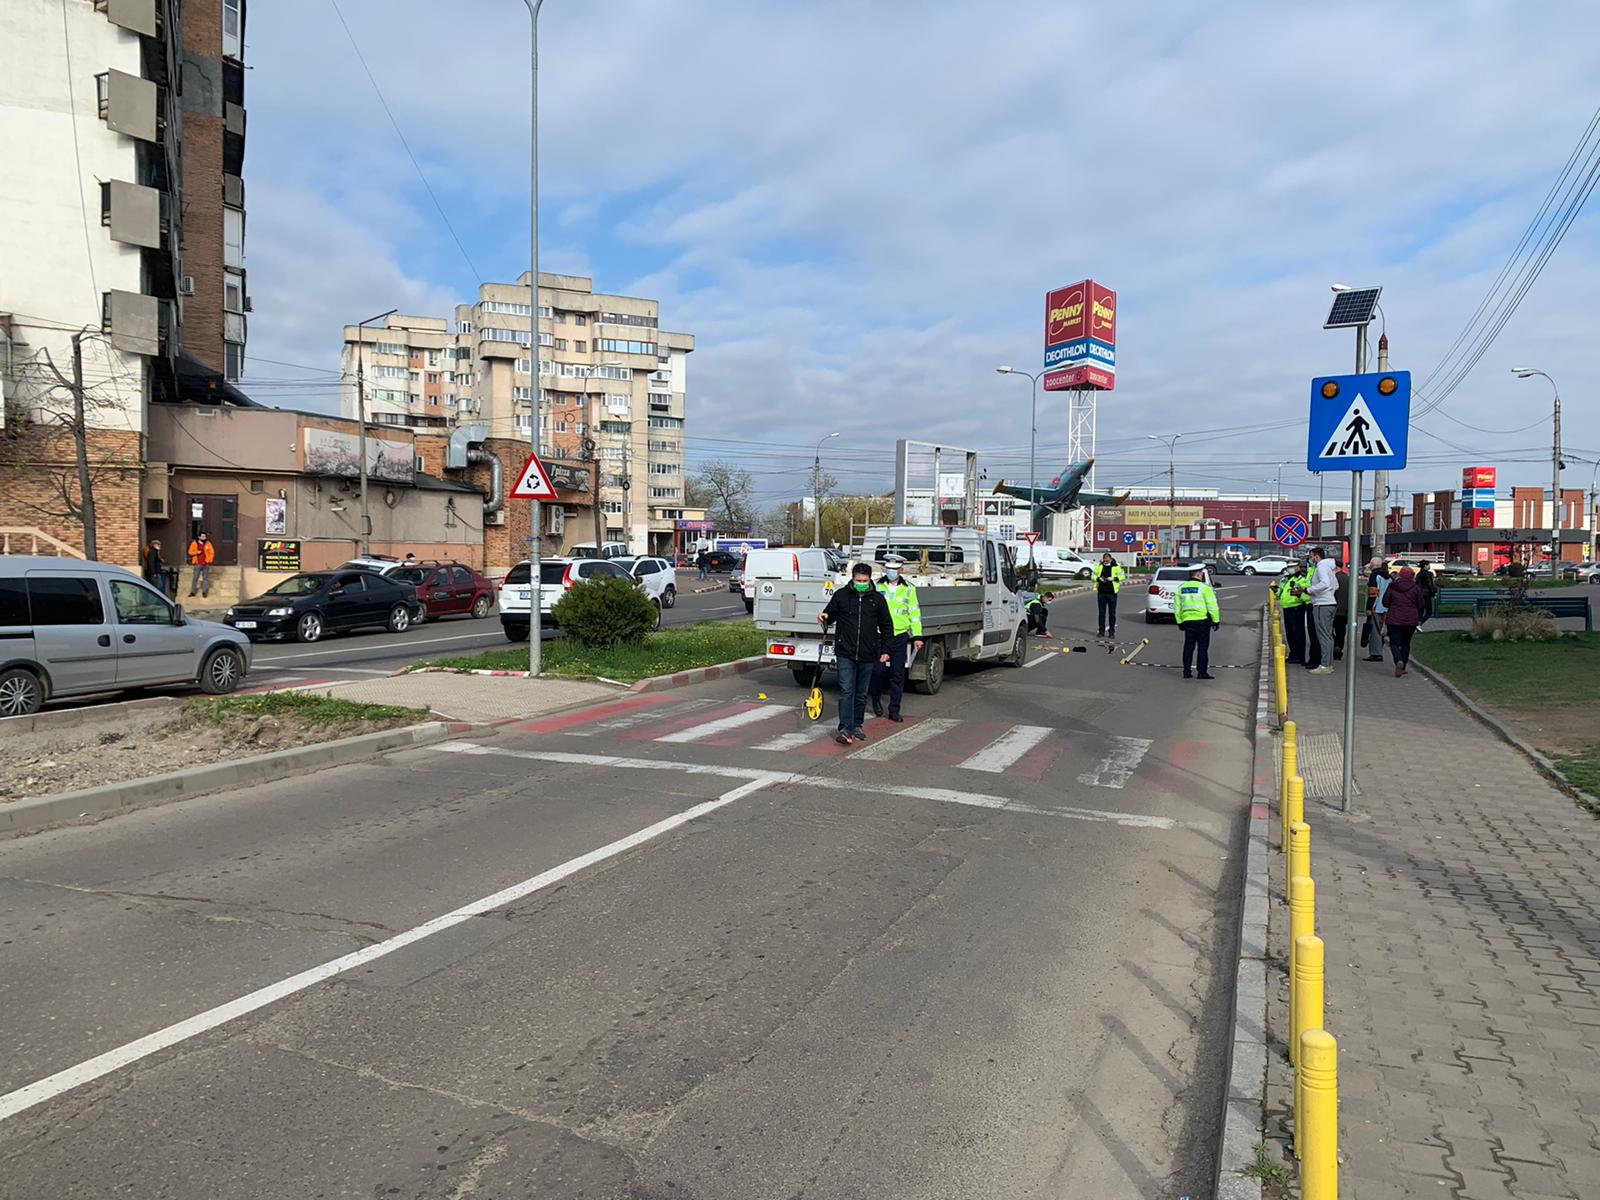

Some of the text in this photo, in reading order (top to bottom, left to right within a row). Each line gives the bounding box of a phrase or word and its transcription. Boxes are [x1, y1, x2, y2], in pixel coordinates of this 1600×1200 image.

[1050, 303, 1084, 323] PENNY
[1092, 300, 1114, 321] PENNY
[1046, 343, 1087, 363] DECATHLON
[1089, 342, 1115, 362] DECATHLON
